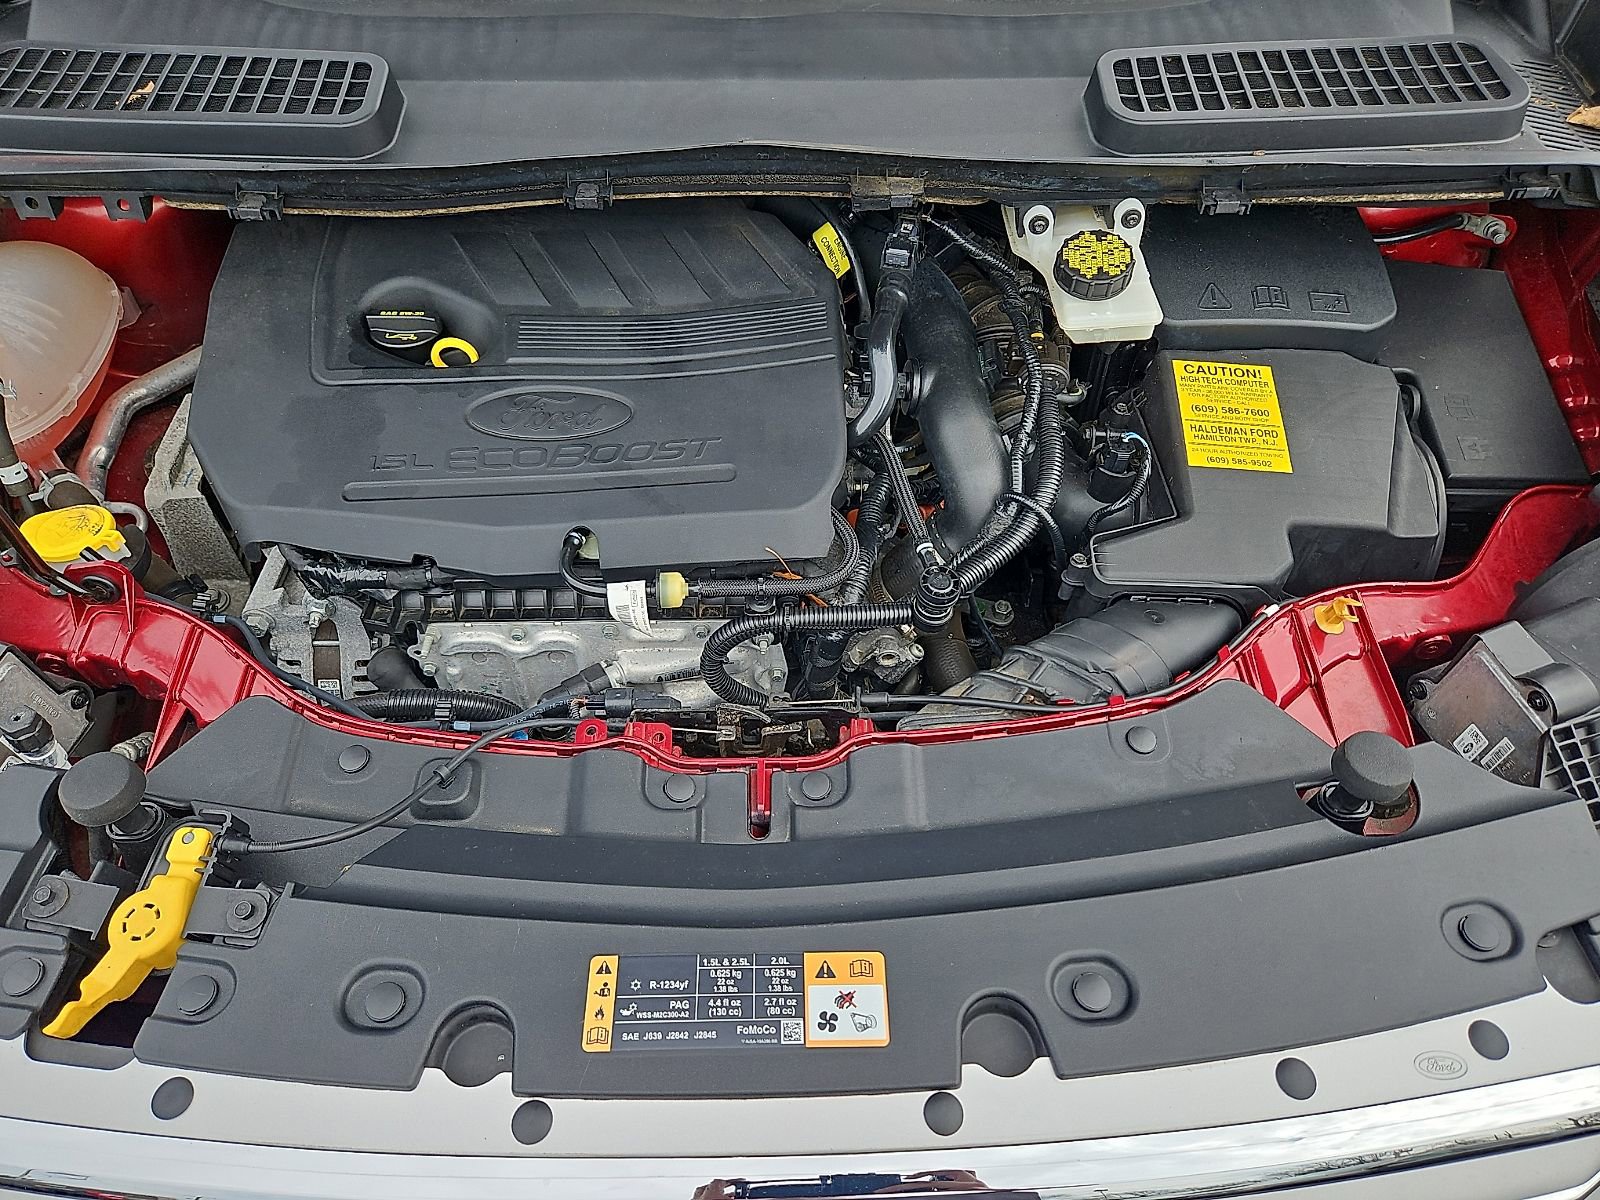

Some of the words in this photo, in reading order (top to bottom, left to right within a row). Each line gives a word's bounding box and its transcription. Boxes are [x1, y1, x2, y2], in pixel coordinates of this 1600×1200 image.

[834, 238, 846, 260] ENGINE
[820, 236, 842, 274] CONNECTION
[1183, 364, 1262, 378] CAUTION!
[1224, 378, 1269, 388] COMPUTER
[500, 394, 603, 431] Ford
[1190, 404, 1218, 413] (609)
[1221, 406, 1269, 416] 586-7600
[1189, 424, 1247, 435] HALDEMAN
[1249, 428, 1278, 438] FORD
[1193, 434, 1236, 442] HAMILTON
[1206, 456, 1229, 464] (609)
[1231, 457, 1272, 467] 585-9502
[710, 970, 730, 978] 0.625
[732, 969, 742, 979] kg
[787, 969, 796, 978] kg
[650, 981, 689, 990] R-1234yf
[670, 1001, 689, 1009] PAG
[709, 1007, 727, 1017] (130
[730, 1007, 742, 1016] cc)
[767, 1007, 782, 1016] (80
[785, 1006, 796, 1016] cc)
[737, 1025, 776, 1035] FoMoCo
[666, 1032, 688, 1040] J2842
[1426, 1056, 1456, 1072] Ford
